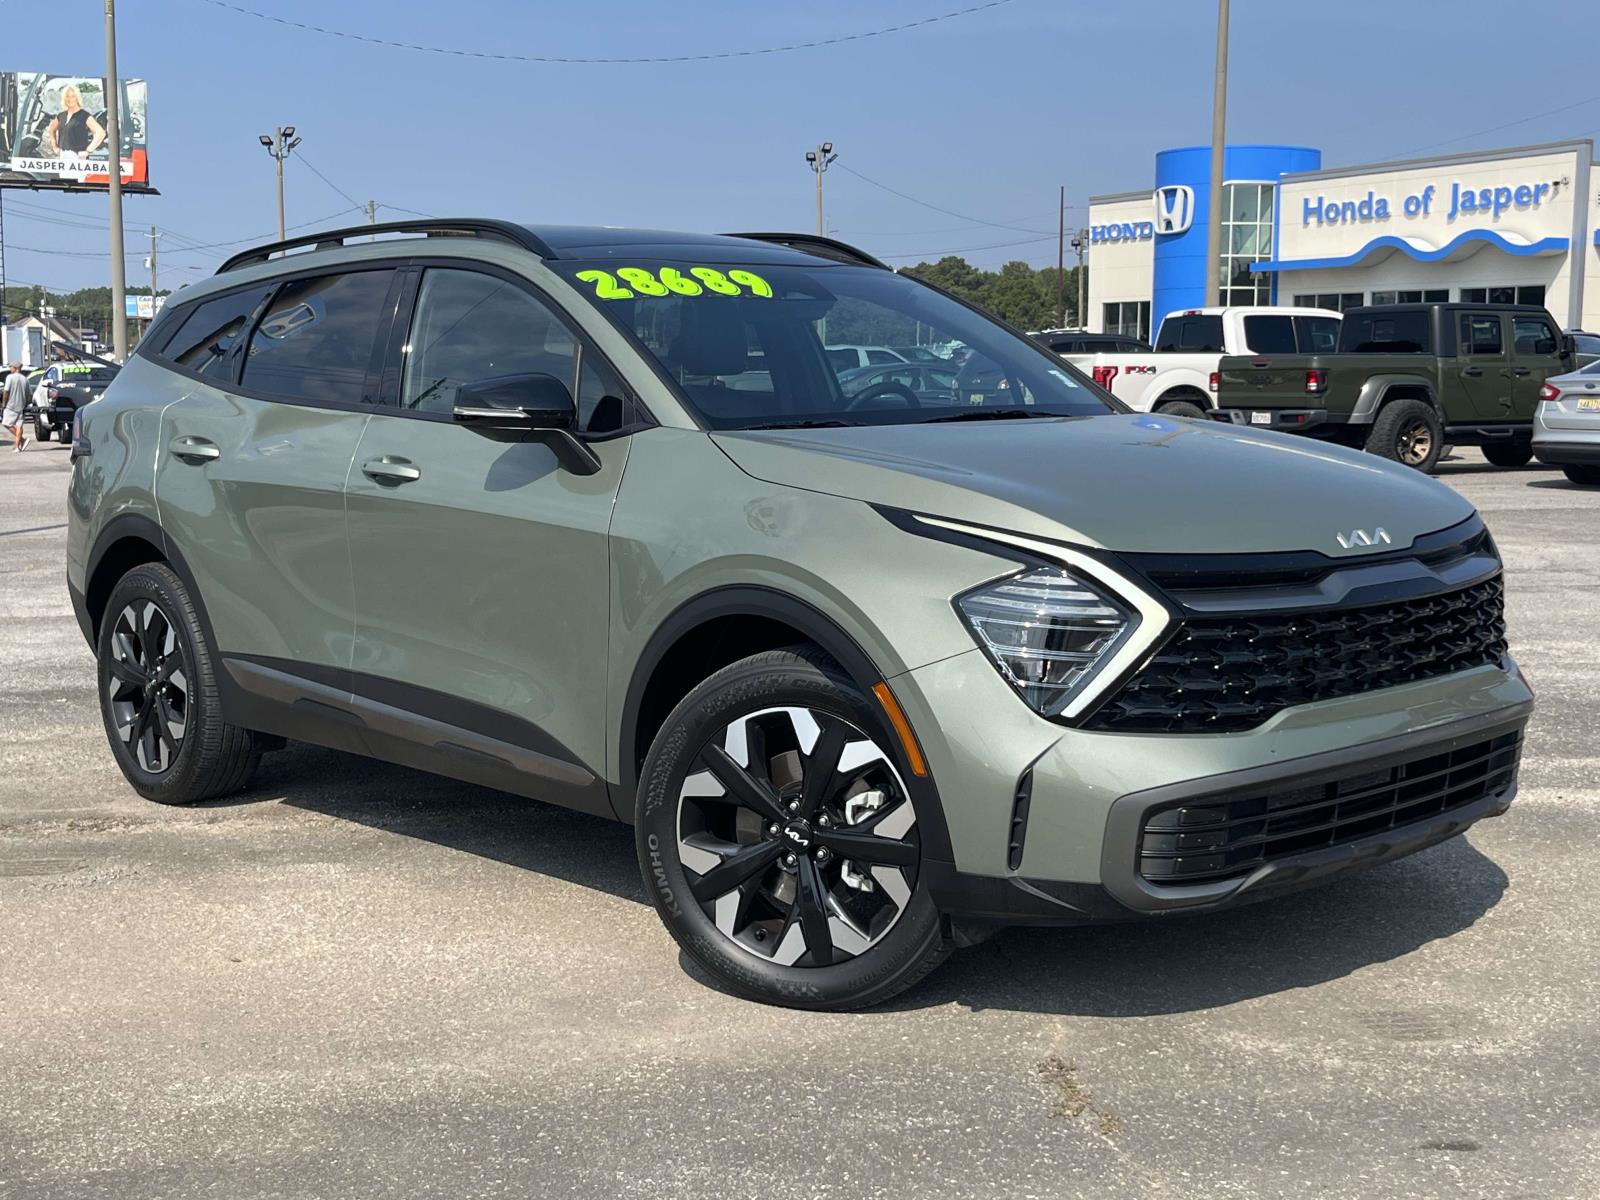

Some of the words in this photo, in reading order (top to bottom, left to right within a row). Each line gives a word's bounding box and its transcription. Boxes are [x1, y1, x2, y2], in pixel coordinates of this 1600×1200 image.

[20, 160, 66, 171] JASPER
[69, 163, 126, 173] ALABAA
[1303, 191, 1391, 225] Honda
[1404, 184, 1435, 217] of
[1448, 181, 1550, 220] Jasper
[1091, 221, 1153, 242] HOND
[576, 267, 773, 299] 28689
[1125, 366, 1157, 375] FX4
[648, 833, 683, 919] KUMHO
